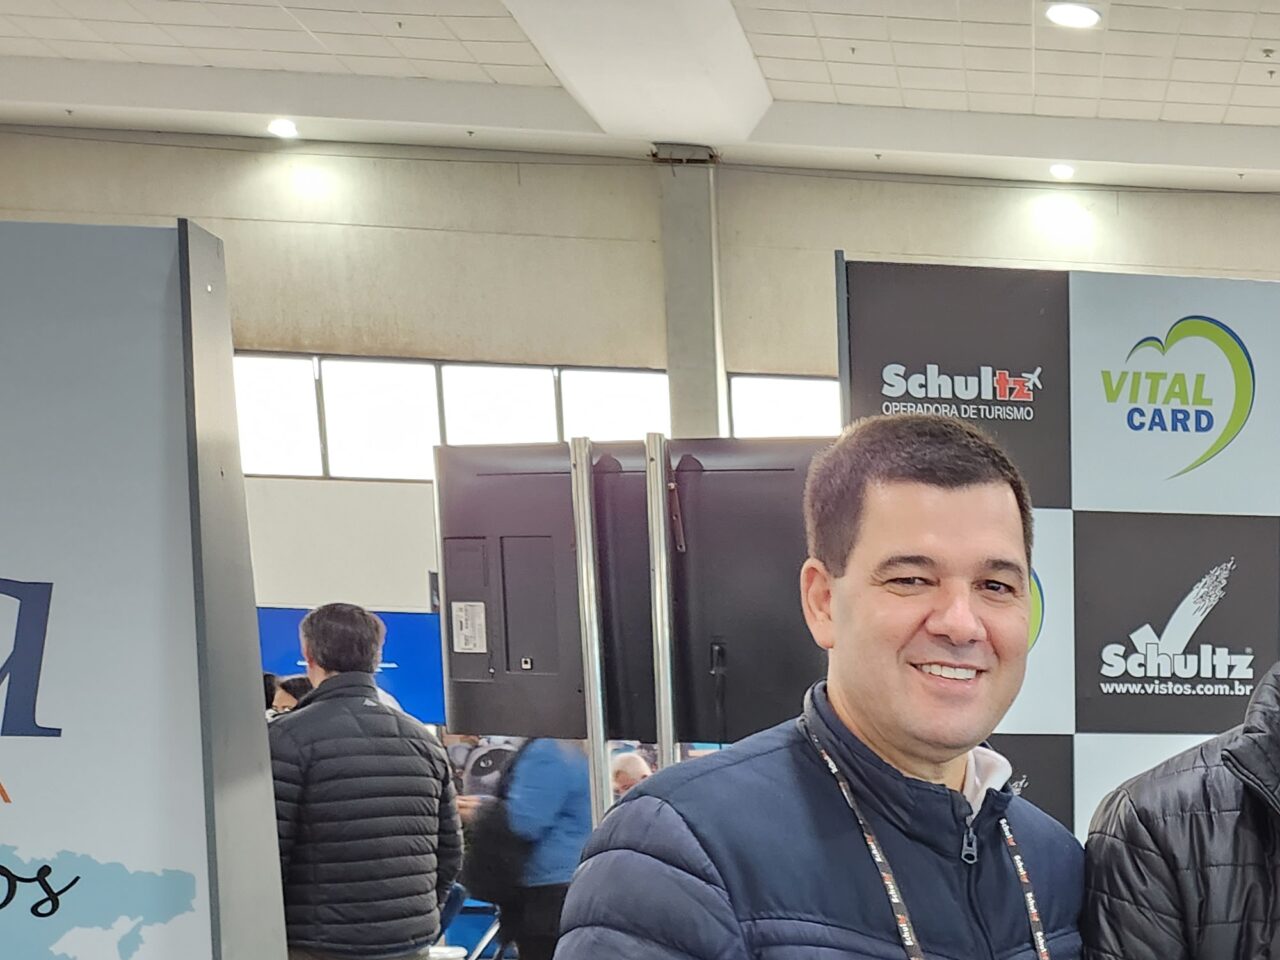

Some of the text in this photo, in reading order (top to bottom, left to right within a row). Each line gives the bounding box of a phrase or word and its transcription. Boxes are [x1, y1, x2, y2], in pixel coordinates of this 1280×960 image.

[881, 363, 1034, 402] Schultz
[1101, 370, 1213, 406] VITAL
[882, 401, 1034, 421] OPERADORA DE TURISMO
[1127, 407, 1215, 433] CARD
[1100, 643, 1255, 679] Schultz
[1100, 680, 1254, 696] www.vistos.com.br
